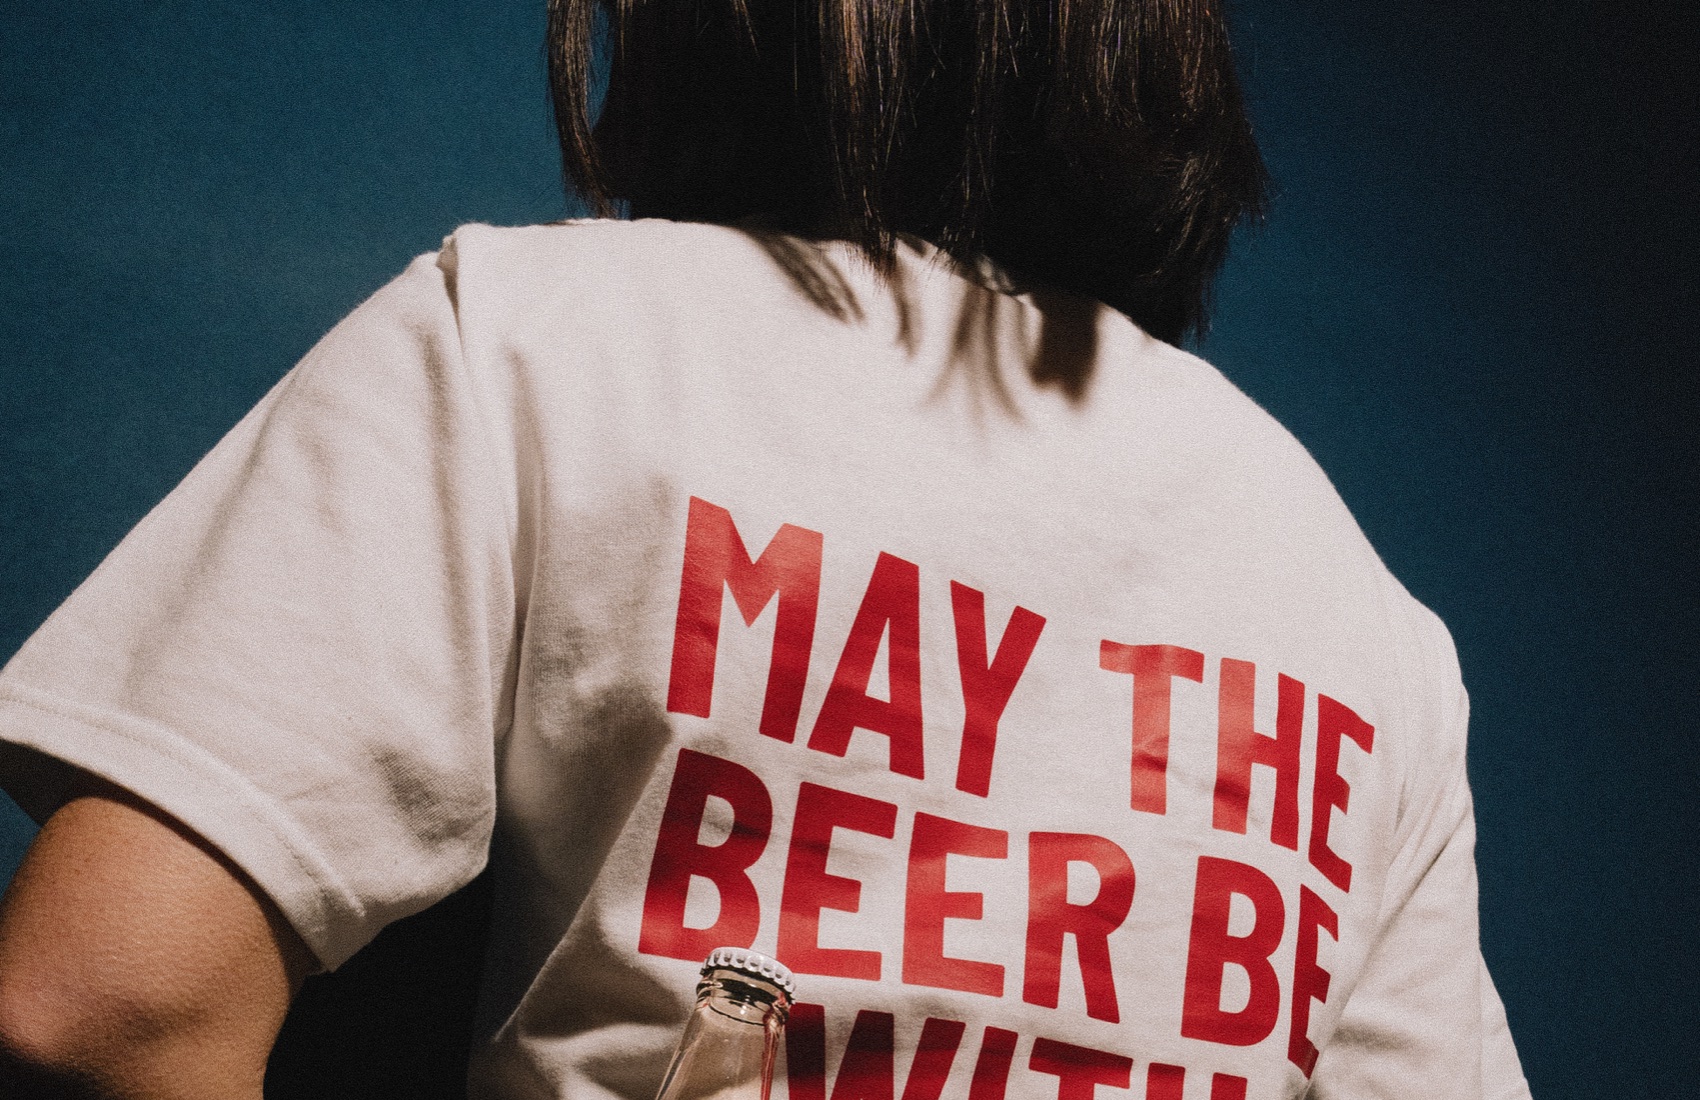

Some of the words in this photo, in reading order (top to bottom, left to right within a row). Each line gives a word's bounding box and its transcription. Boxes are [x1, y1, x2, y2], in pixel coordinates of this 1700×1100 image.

[666, 495, 1047, 799] MAY
[1099, 639, 1376, 893] THE
[638, 747, 1137, 1025] BEER
[1179, 855, 1341, 1079] BE
